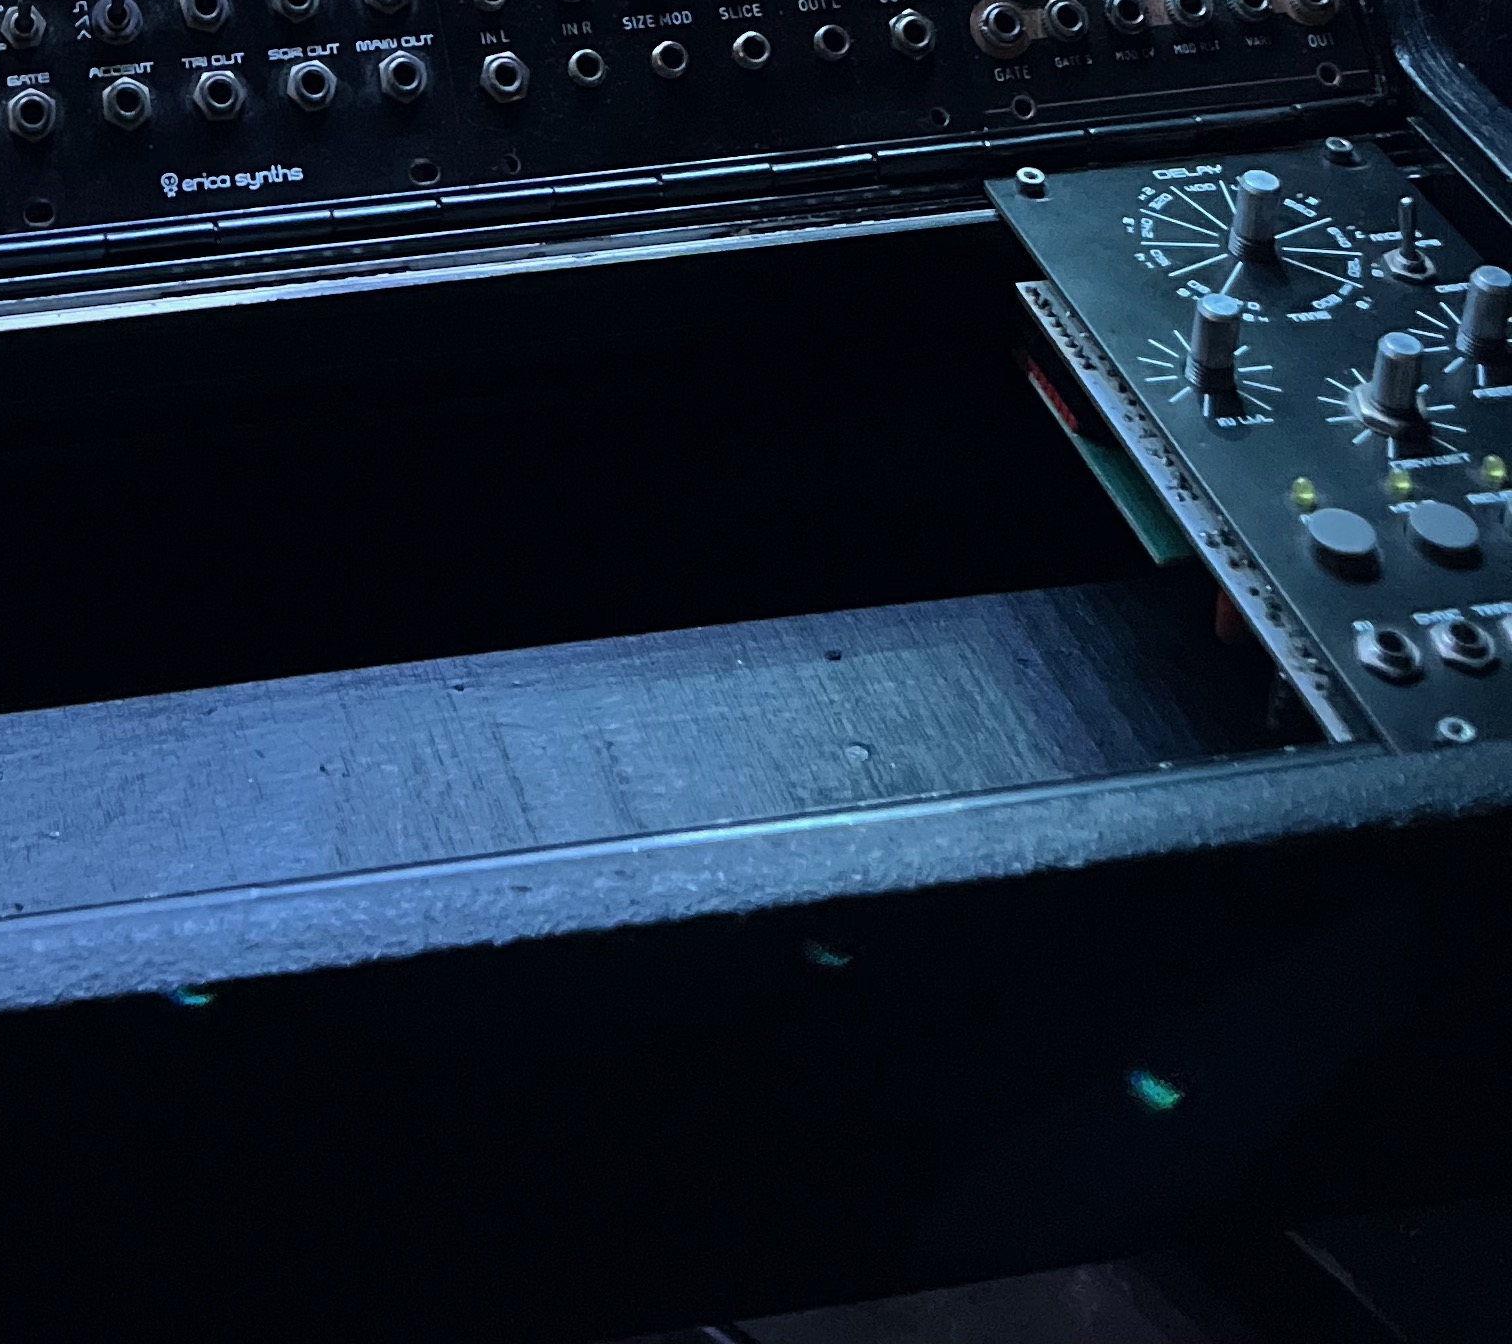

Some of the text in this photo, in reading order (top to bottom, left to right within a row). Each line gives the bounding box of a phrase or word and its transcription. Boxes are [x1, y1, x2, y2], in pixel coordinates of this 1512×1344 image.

[719, 4, 763, 20] SLICE
[622, 11, 692, 30] SIZE MOD
[402, 34, 434, 48] OUT
[7, 72, 50, 86] GATE
[89, 63, 154, 79] ACCENT
[995, 66, 1032, 81] GATE
[182, 165, 303, 192] erica synths
